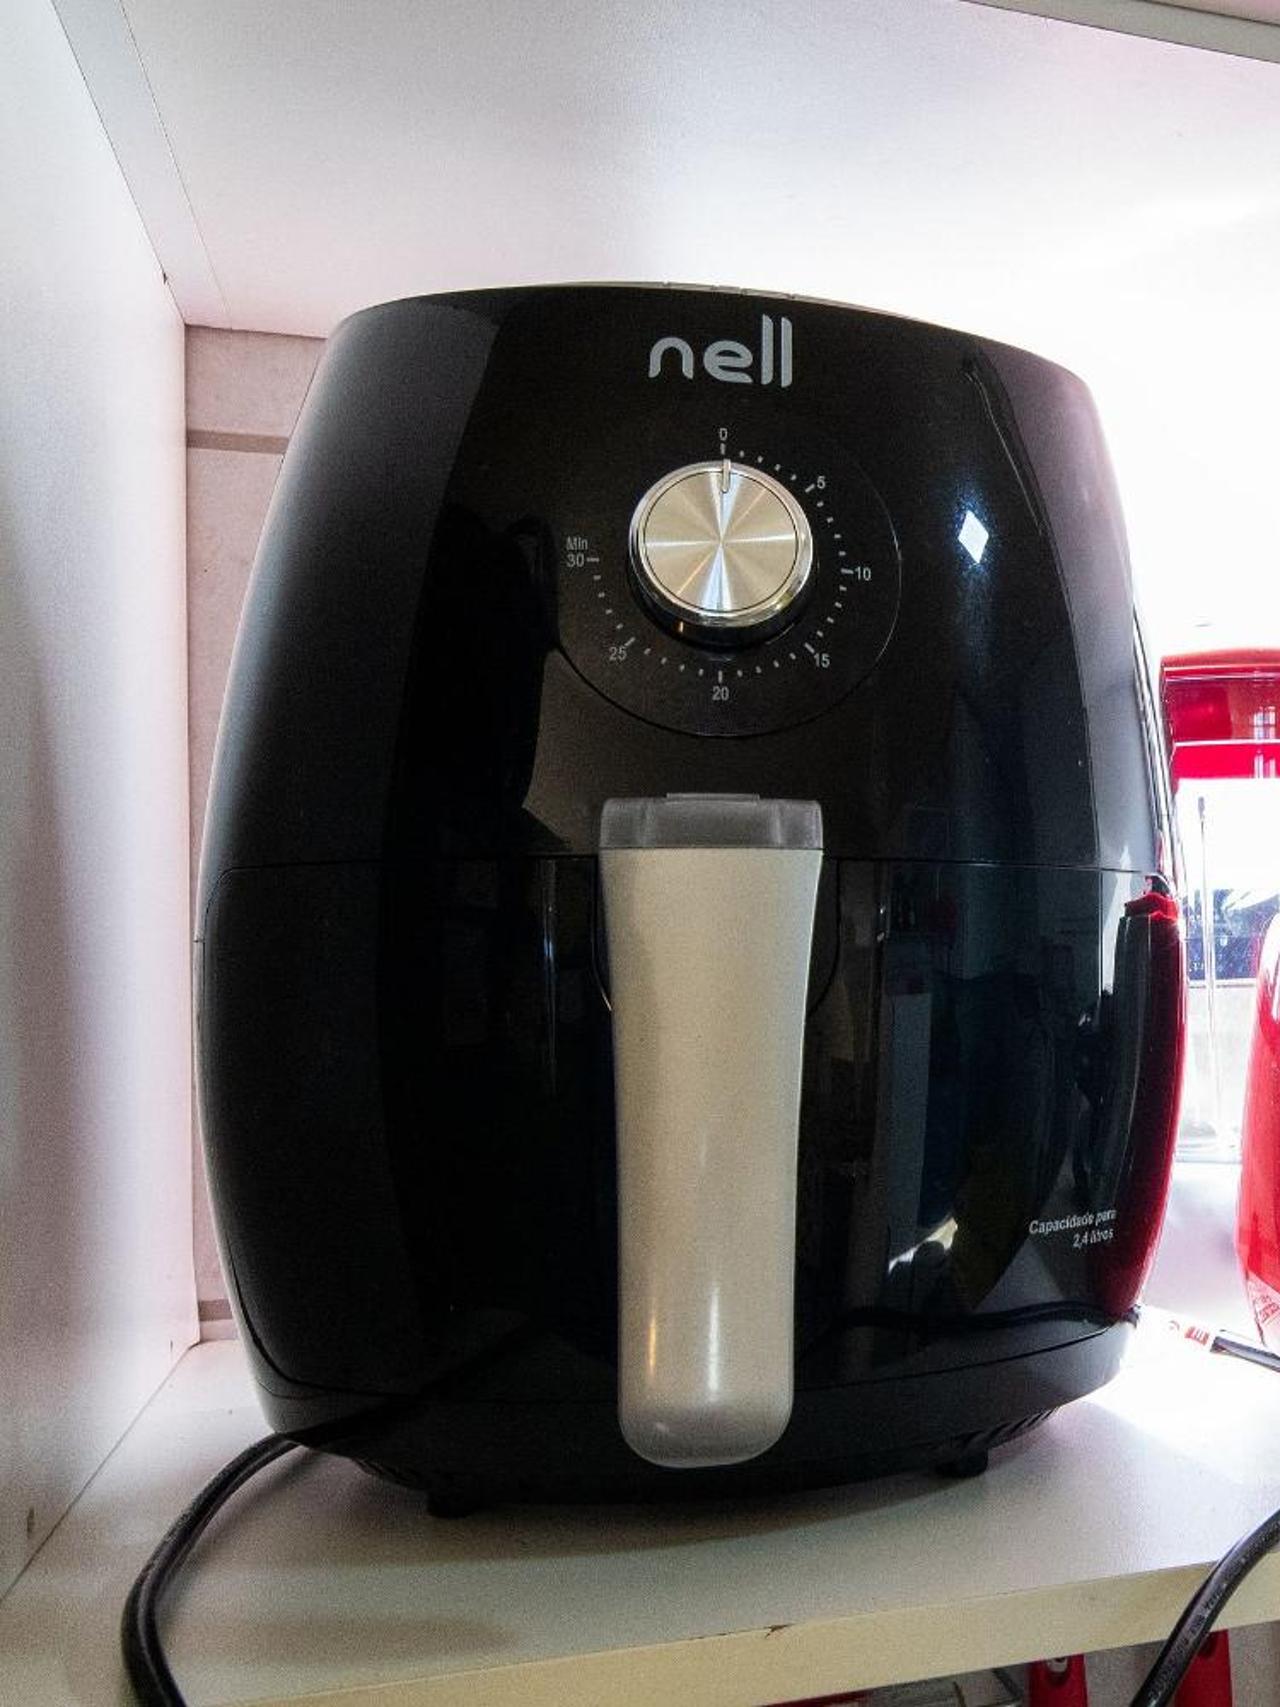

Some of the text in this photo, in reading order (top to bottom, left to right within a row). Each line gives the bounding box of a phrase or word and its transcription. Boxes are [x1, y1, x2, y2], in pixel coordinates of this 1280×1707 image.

[648, 314, 793, 387] nell
[719, 428, 728, 441] 0
[816, 476, 826, 490] 5
[566, 537, 588, 551] Min
[566, 554, 585, 568] 30
[854, 567, 871, 581] 10
[609, 646, 628, 661] 25
[813, 653, 831, 668] 15
[712, 687, 730, 701] 20
